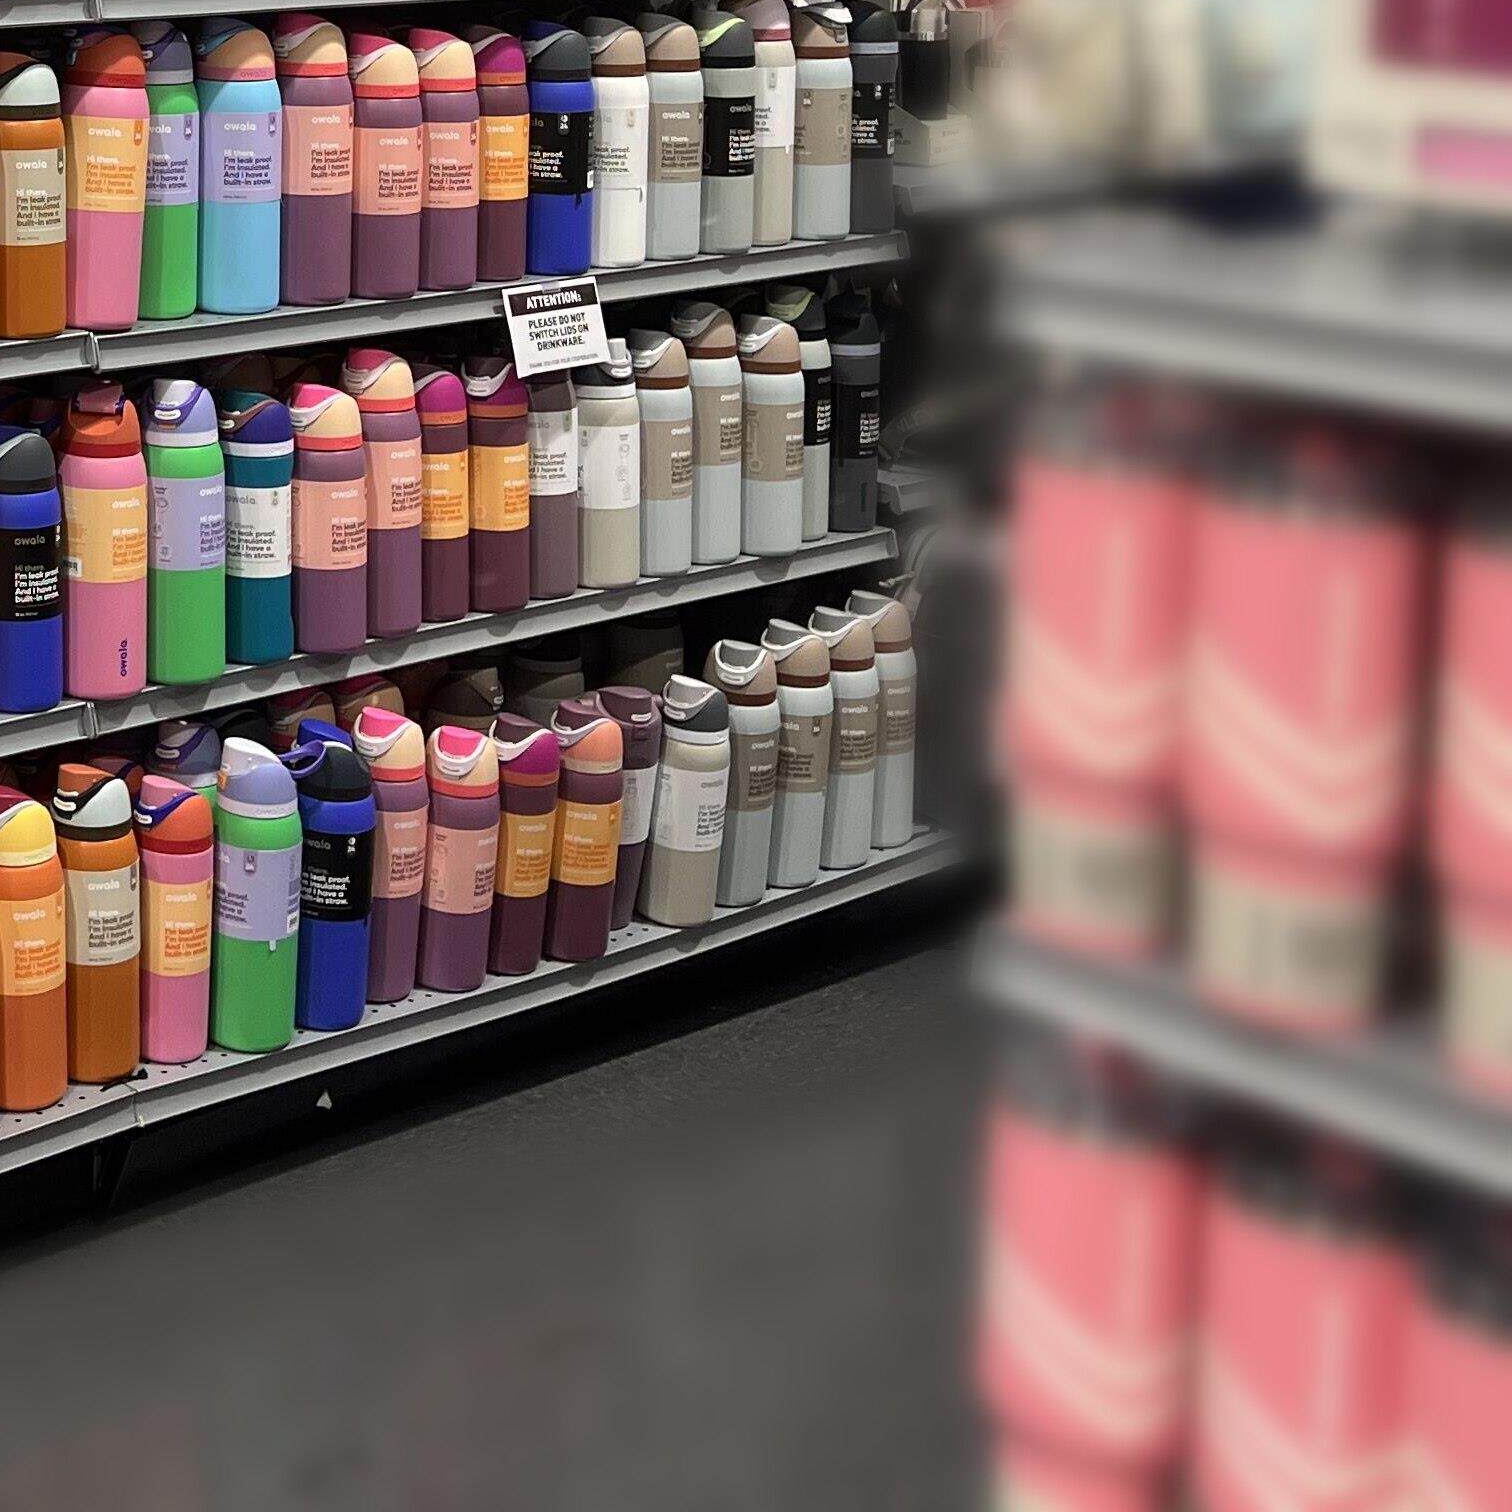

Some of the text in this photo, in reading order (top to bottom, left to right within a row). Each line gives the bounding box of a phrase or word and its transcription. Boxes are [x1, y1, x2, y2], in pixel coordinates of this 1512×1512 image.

[662, 110, 690, 119] owala
[224, 122, 255, 131] owala
[88, 128, 122, 137] owala
[16, 160, 47, 169] owala
[527, 290, 582, 309] ATTENTION:
[528, 313, 585, 328] PLEASE DO NOT
[529, 324, 589, 341] SWITCH LIDS ON
[14, 535, 45, 545] owala
[119, 639, 127, 677] owala
